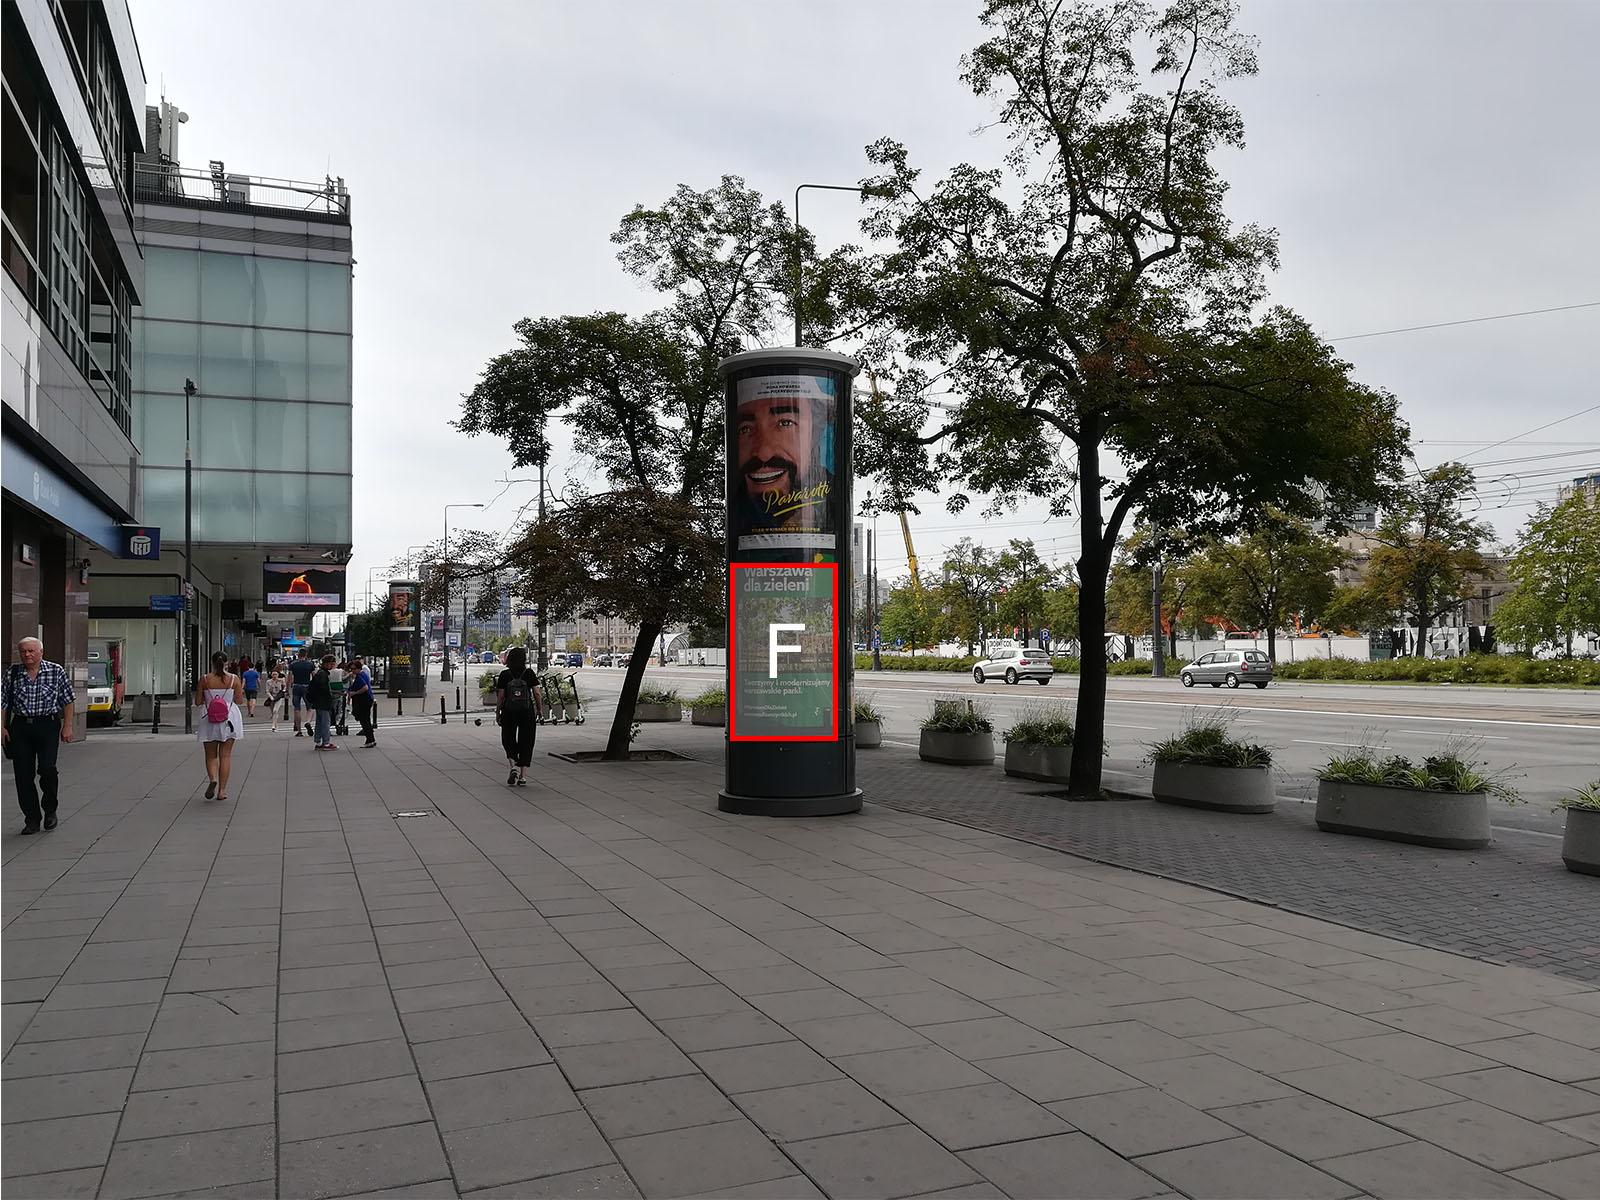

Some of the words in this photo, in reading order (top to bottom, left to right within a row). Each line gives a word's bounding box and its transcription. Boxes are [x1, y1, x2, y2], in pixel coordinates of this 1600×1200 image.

[762, 481, 831, 513] Pavarotti
[744, 577, 761, 592] dla
[764, 577, 810, 592] zieleni
[780, 678, 831, 688] modernizujemy
